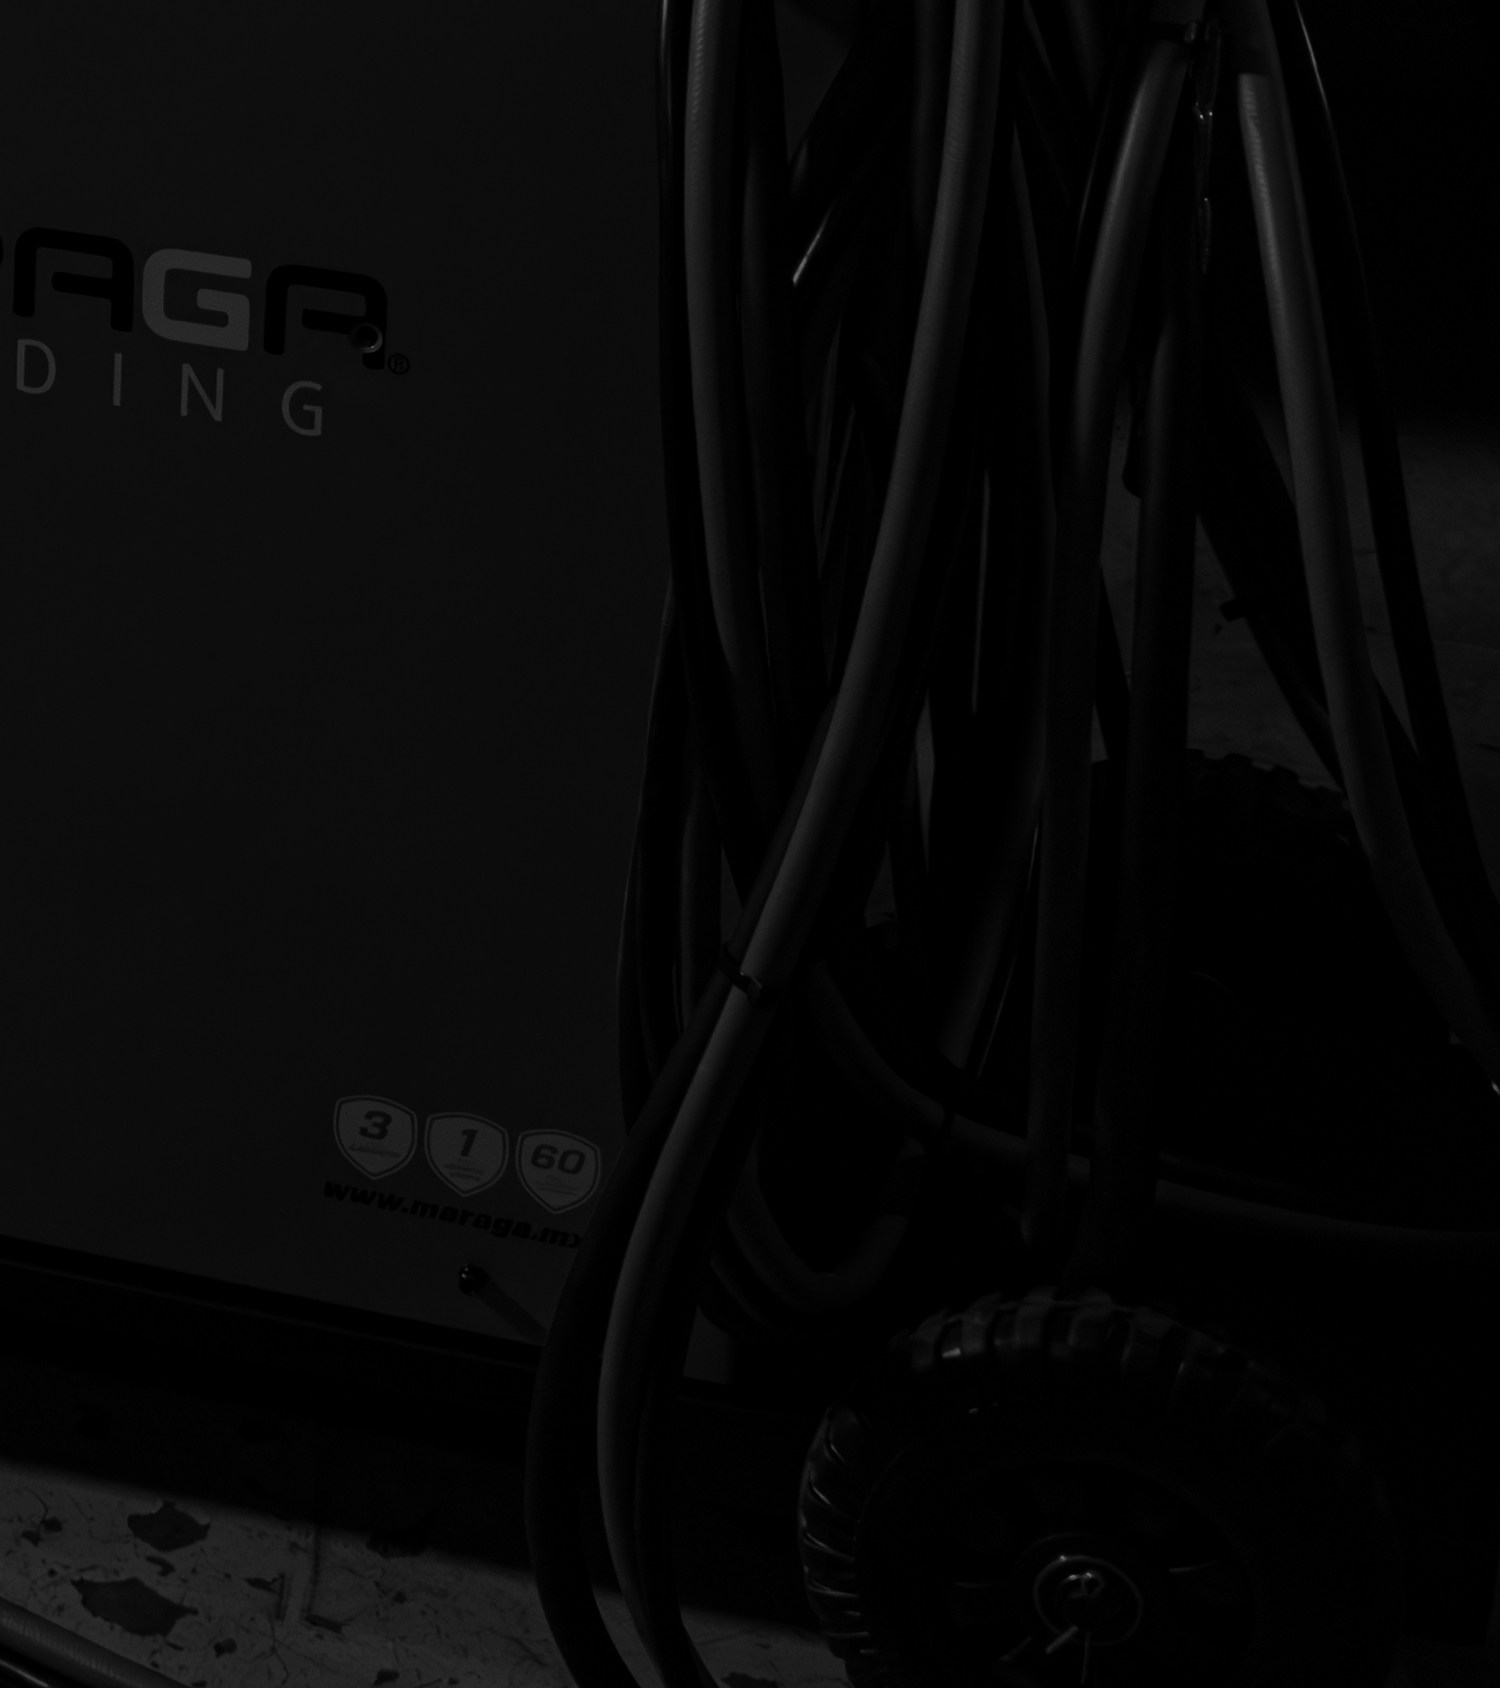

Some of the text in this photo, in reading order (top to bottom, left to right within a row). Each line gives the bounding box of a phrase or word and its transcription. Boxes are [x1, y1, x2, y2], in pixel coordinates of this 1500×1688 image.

[359, 1110, 393, 1140] 3
[458, 1128, 478, 1158] 1
[530, 1143, 587, 1175] 60
